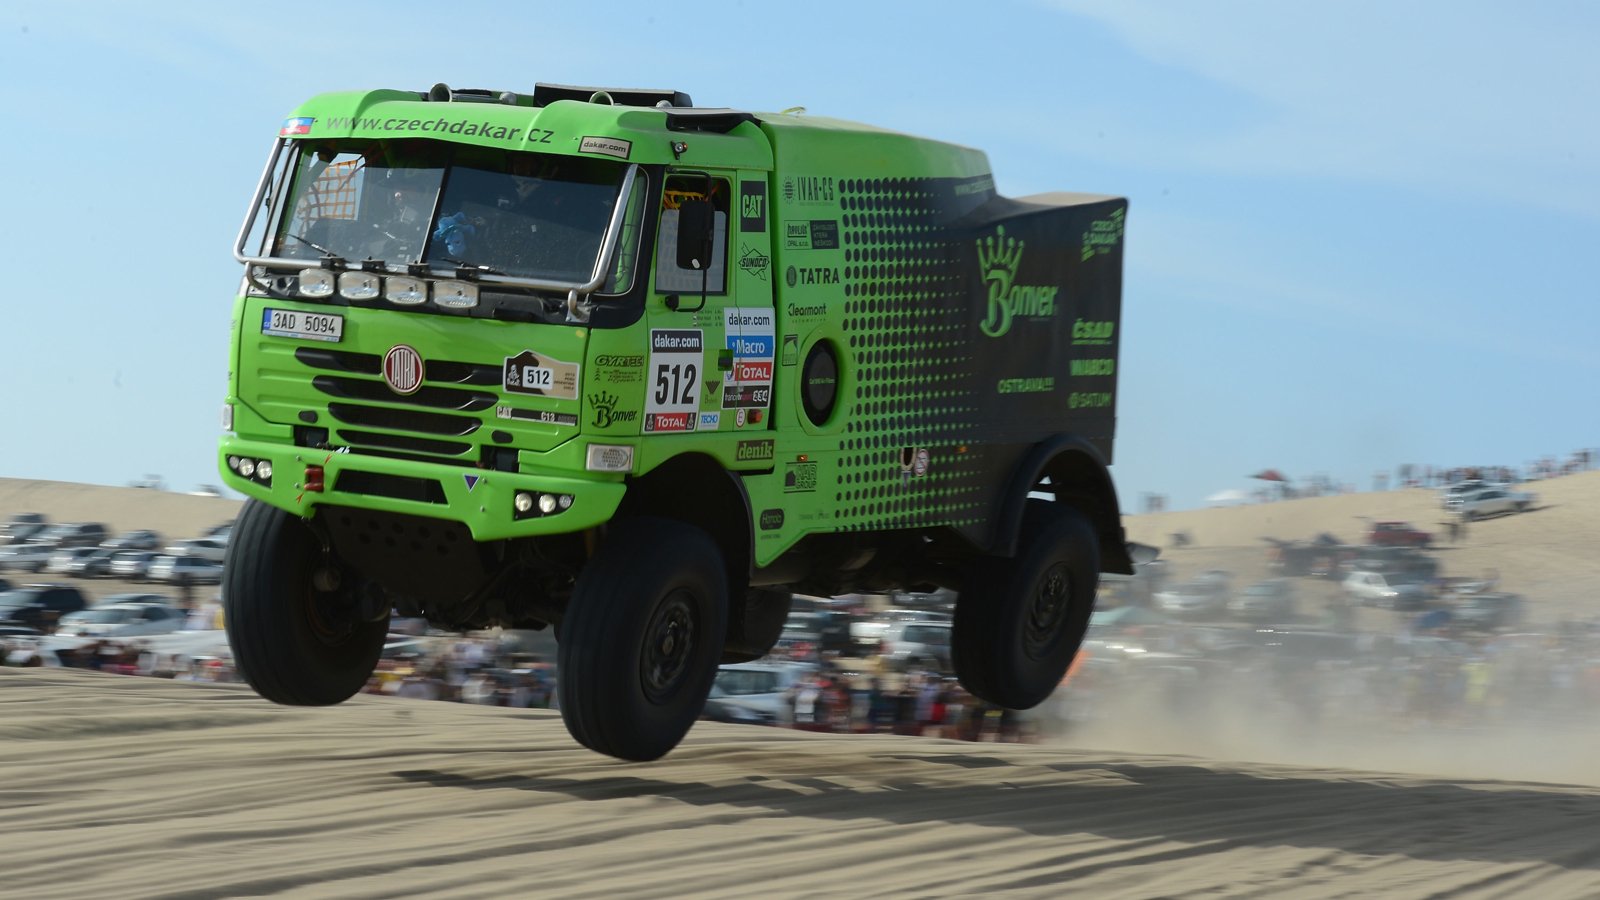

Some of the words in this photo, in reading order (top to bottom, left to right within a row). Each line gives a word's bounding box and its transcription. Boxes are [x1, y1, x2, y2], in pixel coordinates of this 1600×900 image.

[325, 115, 555, 145] www.czechdakar.cz
[583, 140, 627, 154] dakar.com
[742, 194, 763, 218] CAT
[741, 257, 767, 268] SUNOCO
[799, 267, 840, 285] TATRA
[787, 302, 827, 317] Clearmont
[979, 269, 1059, 338] Bonver
[273, 312, 297, 331] 3AD
[304, 315, 336, 335] 5094
[728, 312, 770, 326] dakar.com
[654, 334, 700, 349] dakar.com
[735, 339, 766, 354] Macro
[390, 348, 417, 390] TATRA
[527, 369, 551, 385] 512
[736, 363, 770, 379] TOTAL
[655, 363, 697, 405] 512
[496, 406, 513, 419] CAT
[592, 405, 638, 429] Bonver
[656, 415, 686, 429] TOTAL
